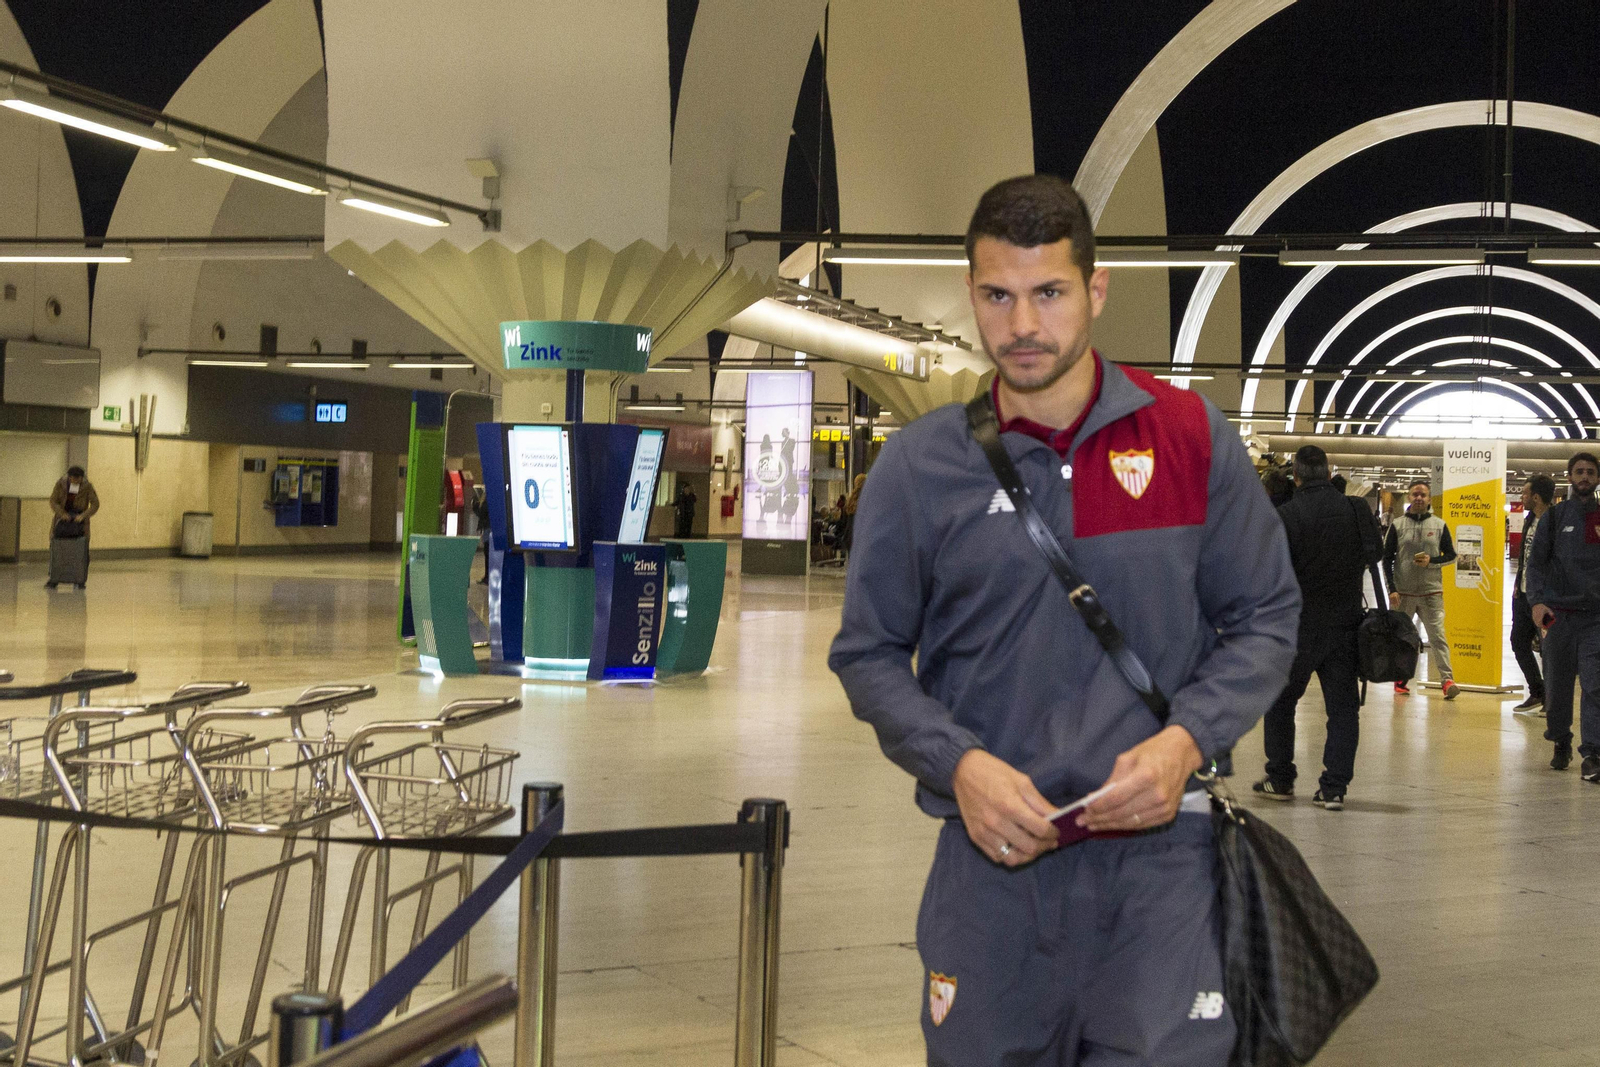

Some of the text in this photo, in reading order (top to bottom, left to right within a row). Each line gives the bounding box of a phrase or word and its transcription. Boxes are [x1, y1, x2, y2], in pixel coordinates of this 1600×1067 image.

[520, 341, 563, 361] Zink
[1448, 446, 1492, 463] vueling
[1449, 466, 1490, 474] CHECK-IN
[633, 559, 657, 571] Zink
[1453, 643, 1482, 651] POSSIBLE
